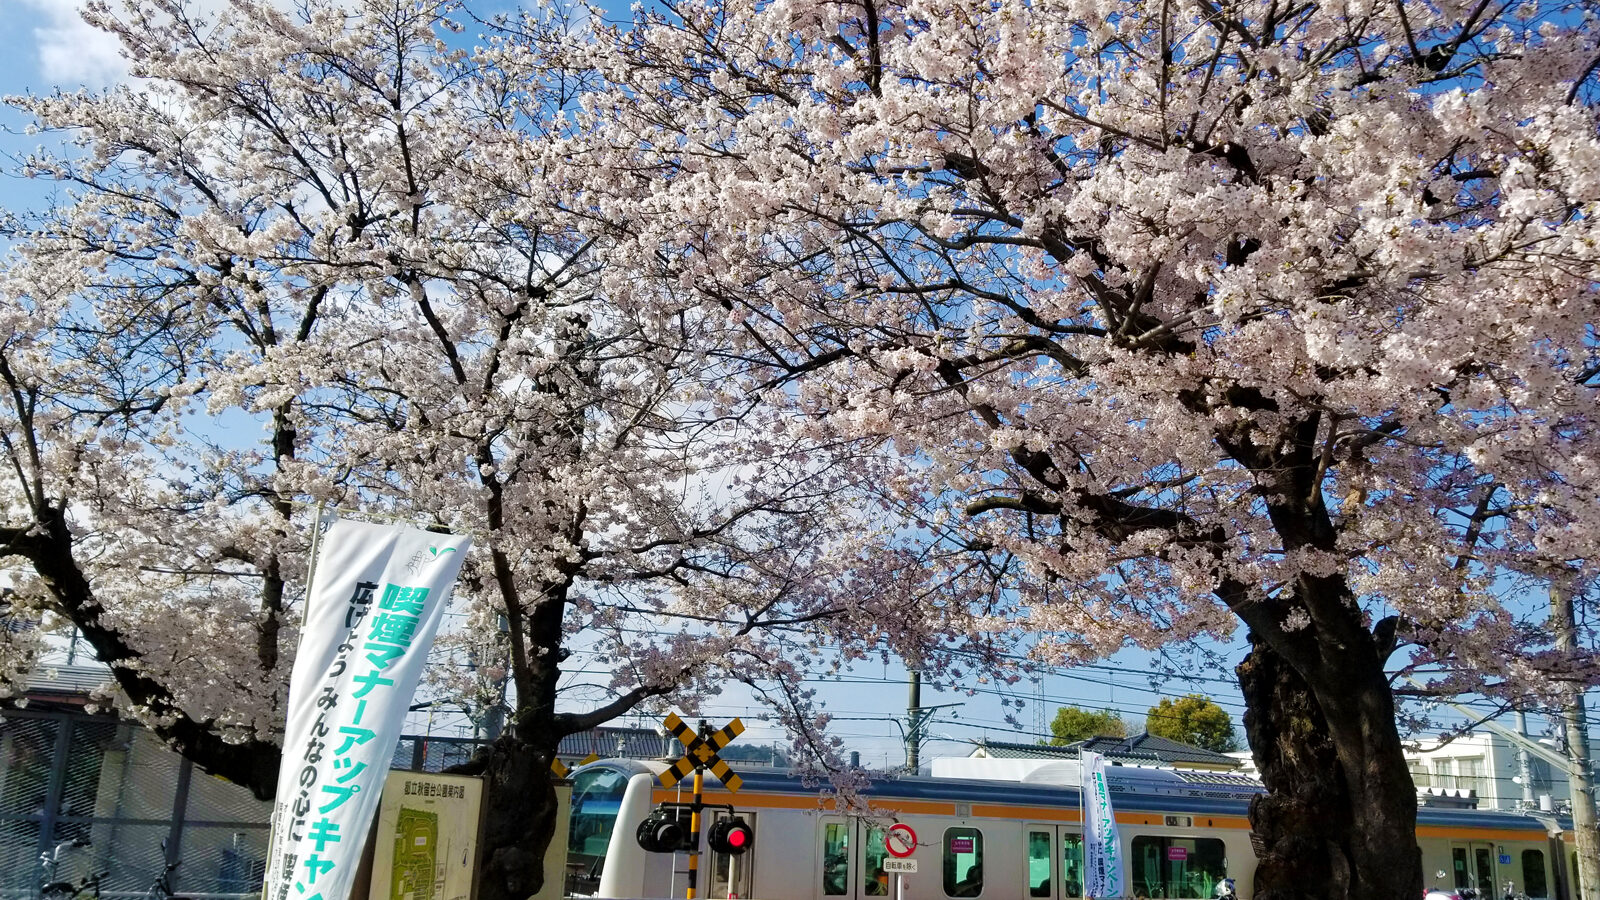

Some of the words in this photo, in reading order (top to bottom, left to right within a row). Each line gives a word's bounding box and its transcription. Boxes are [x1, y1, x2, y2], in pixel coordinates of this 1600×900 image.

[329, 581, 380, 677] 広げよう
[288, 686, 338, 842] みんなの心に
[886, 862, 915, 871] 自転車を除く
